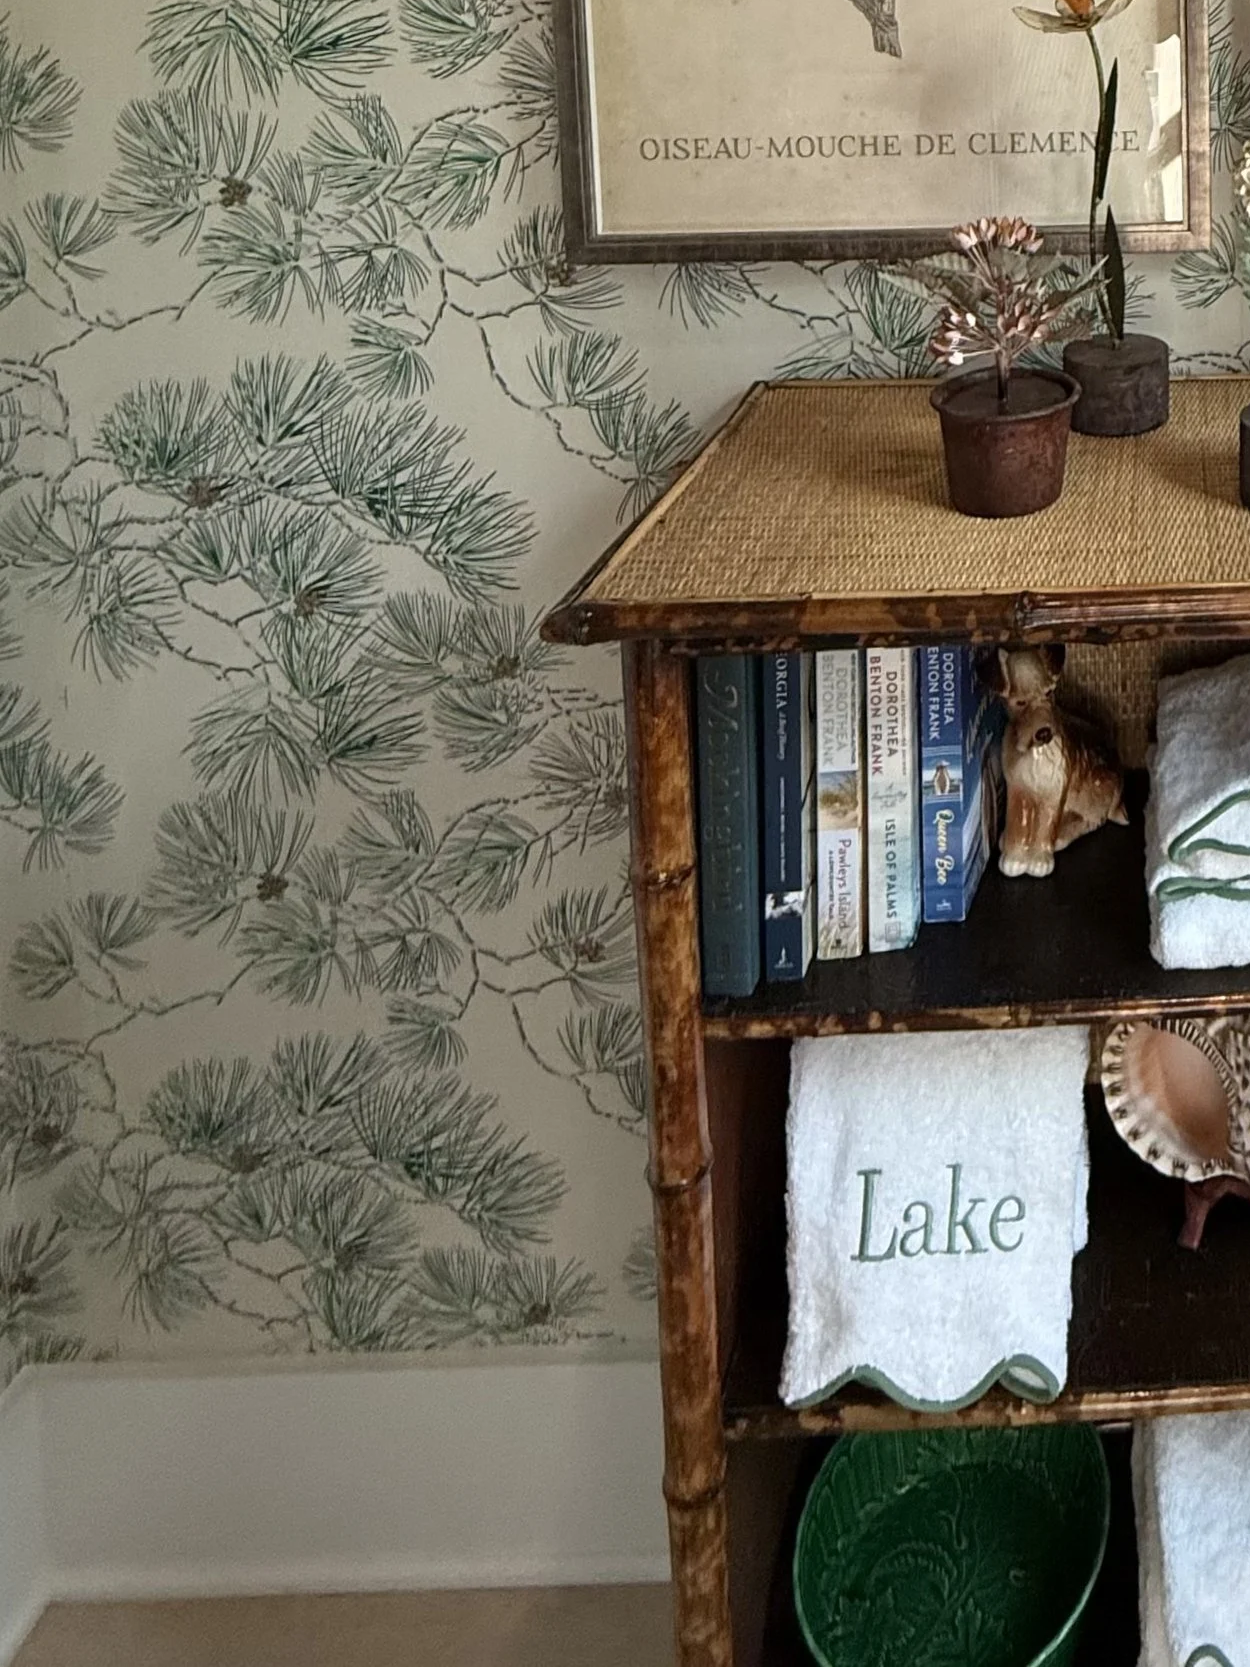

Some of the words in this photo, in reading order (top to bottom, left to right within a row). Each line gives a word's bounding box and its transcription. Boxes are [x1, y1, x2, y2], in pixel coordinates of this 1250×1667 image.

[639, 134, 902, 161] OISEAU-MOUCHE
[915, 133, 956, 156] DE
[821, 654, 834, 714] BENTON
[869, 656, 883, 718] BENTON
[927, 646, 939, 693] ENTON
[943, 652, 955, 725] DOROTHEA
[836, 667, 849, 752] DOROTHEA
[886, 671, 899, 757] DOROTHEA
[928, 697, 940, 741] FRANK
[821, 719, 834, 767] FRANK
[871, 724, 883, 776] FRANK
[885, 818, 896, 847] ISLE
[933, 809, 955, 853] Queen
[836, 838, 852, 889] Pawleys
[886, 851, 896, 870] OF
[935, 855, 955, 886] Bee
[838, 892, 852, 929] Island
[886, 874, 898, 919] PALMS
[850, 1162, 1026, 1262] Lake
